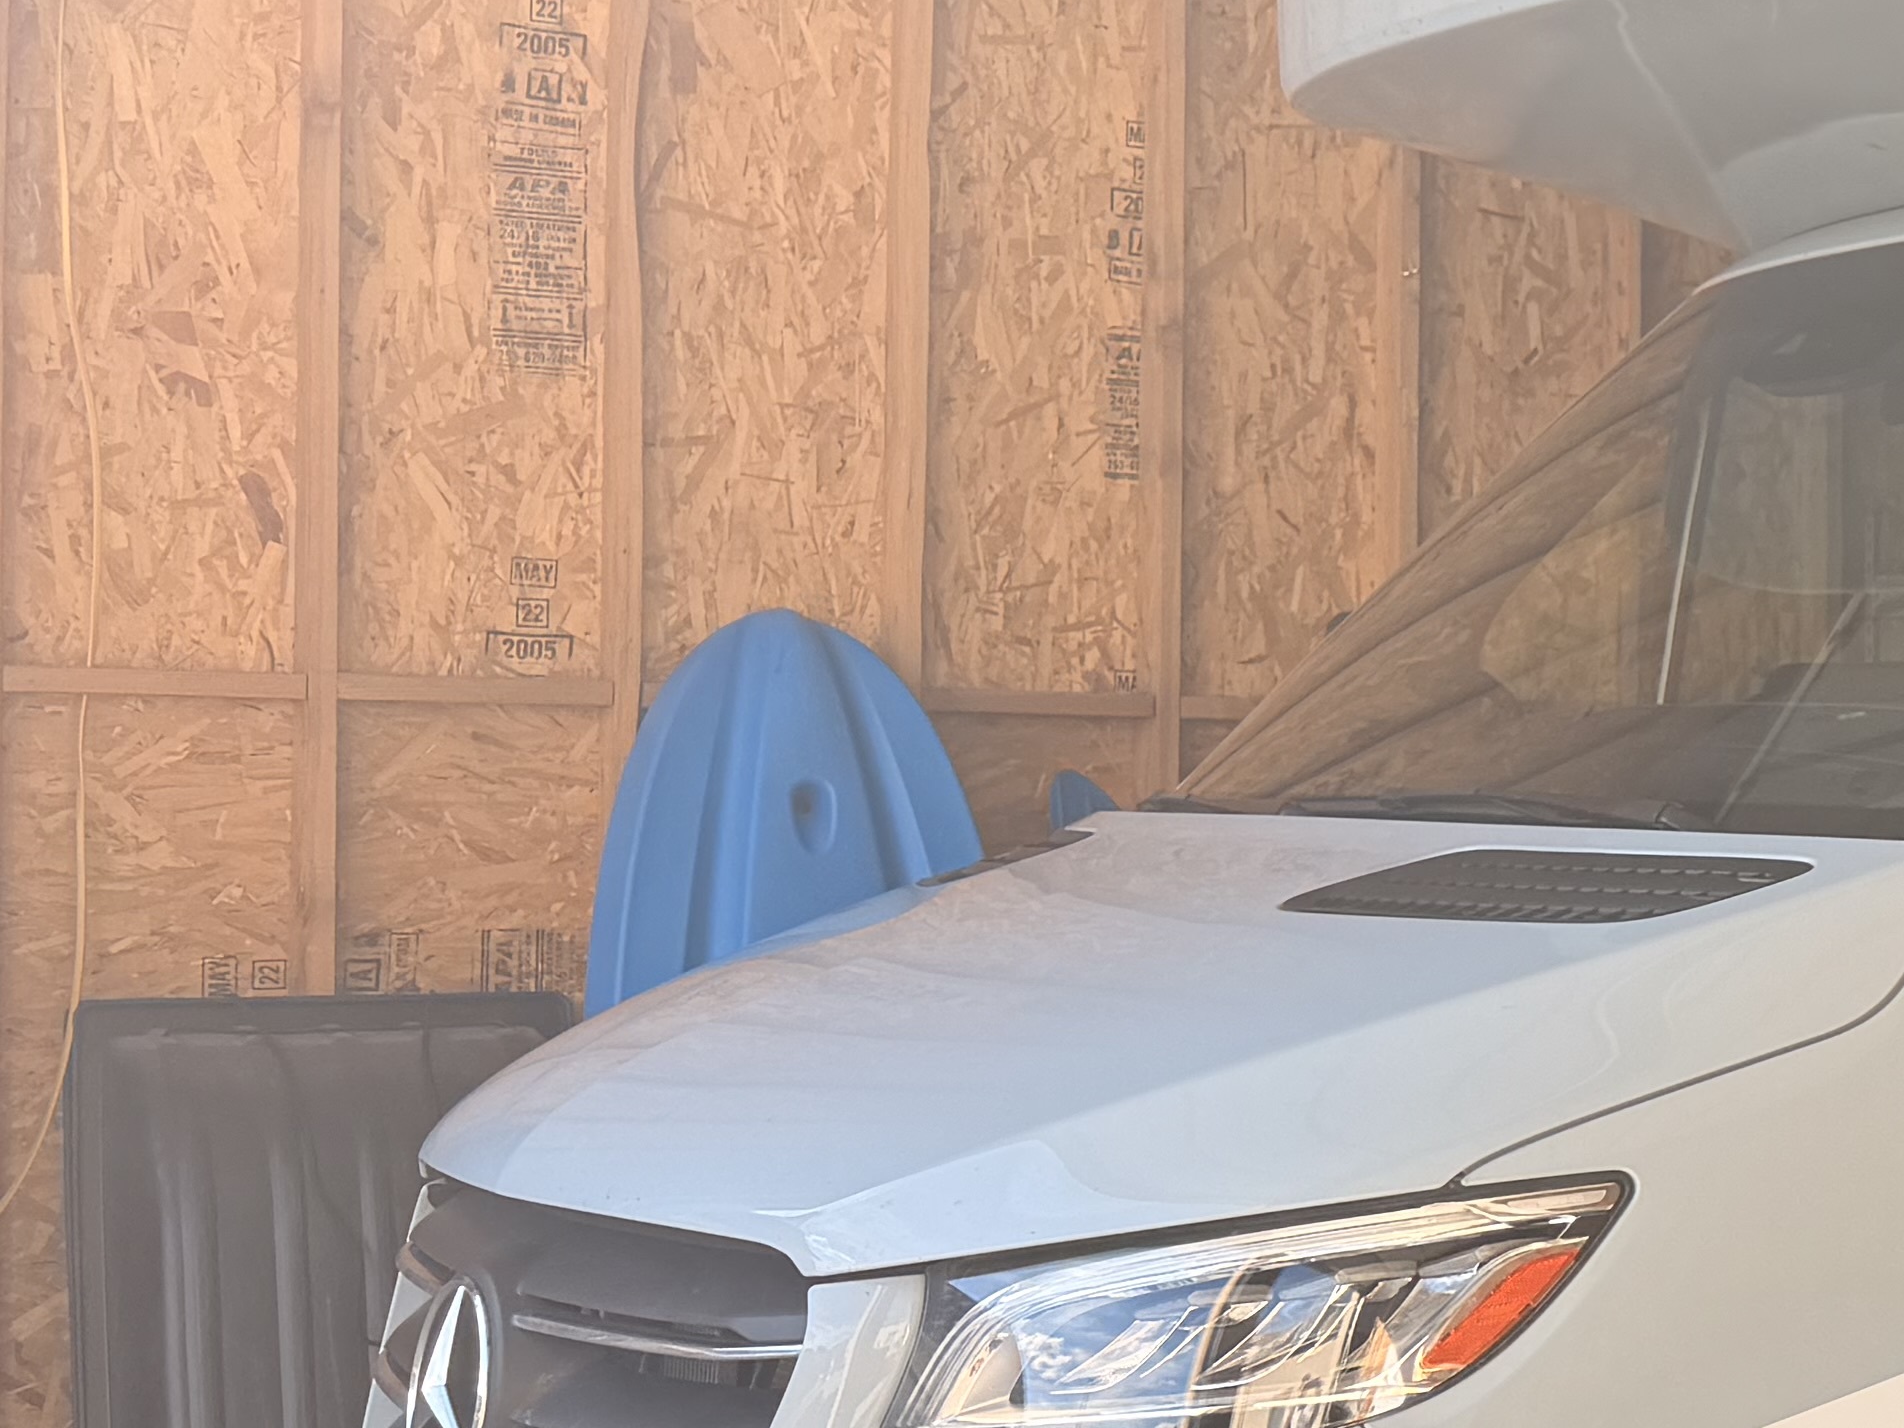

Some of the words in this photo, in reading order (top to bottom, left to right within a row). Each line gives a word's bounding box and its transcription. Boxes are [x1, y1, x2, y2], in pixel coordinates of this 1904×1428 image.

[515, 31, 571, 58] 2005
[537, 74, 551, 97] A
[506, 175, 571, 197] APA
[513, 561, 554, 583] MAY
[521, 602, 545, 623] 22
[502, 637, 557, 661] 2005
[258, 964, 281, 986] 22
[350, 969, 374, 982] A
